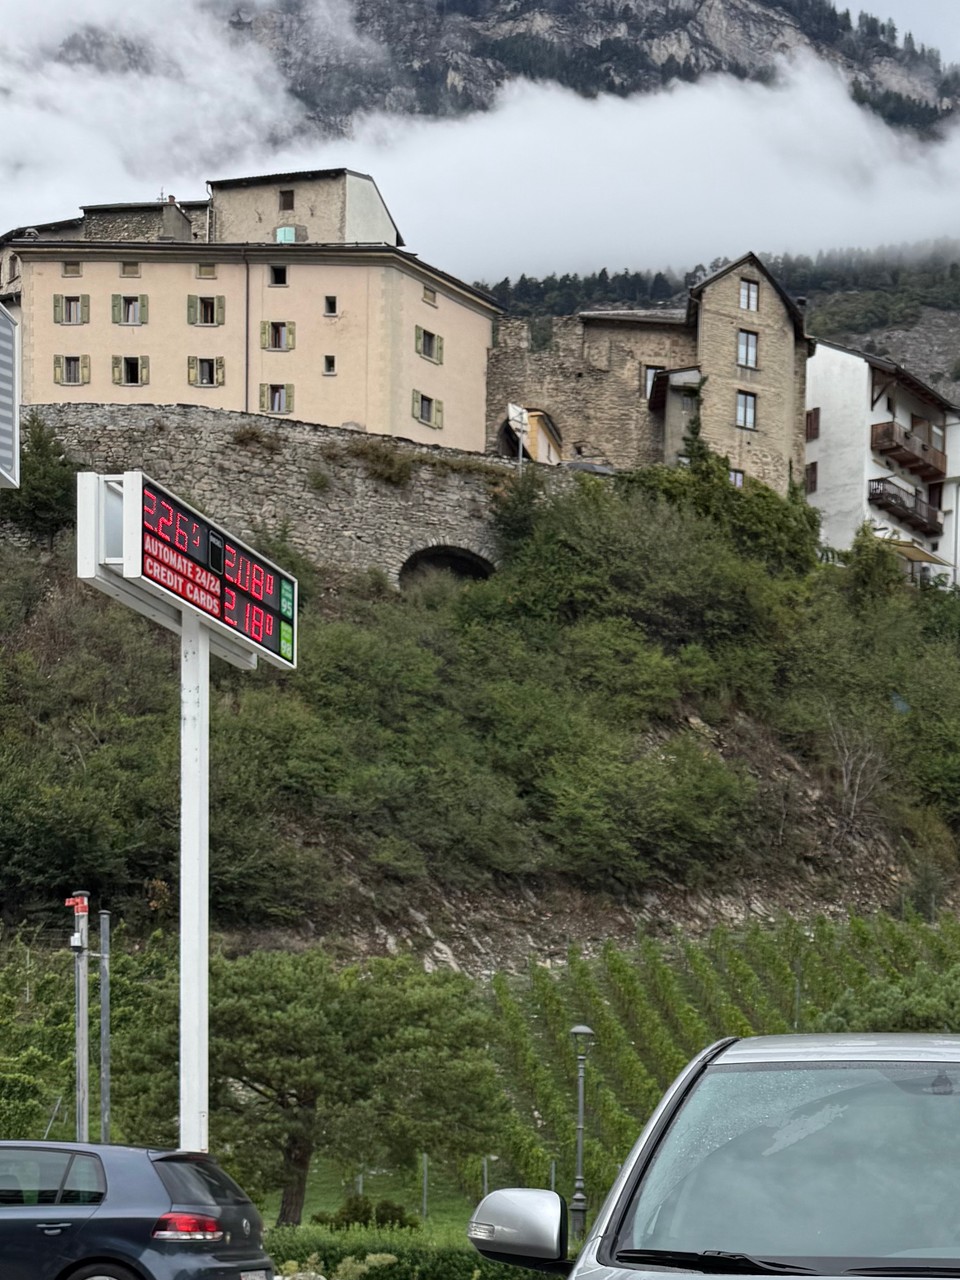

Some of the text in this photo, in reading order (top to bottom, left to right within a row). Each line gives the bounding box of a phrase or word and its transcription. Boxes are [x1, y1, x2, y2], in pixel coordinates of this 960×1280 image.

[144, 537, 193, 578] AUTOMATE
[195, 567, 221, 595] 24/24
[146, 558, 219, 614] CREDIT CARDS
[281, 598, 292, 617] 95
